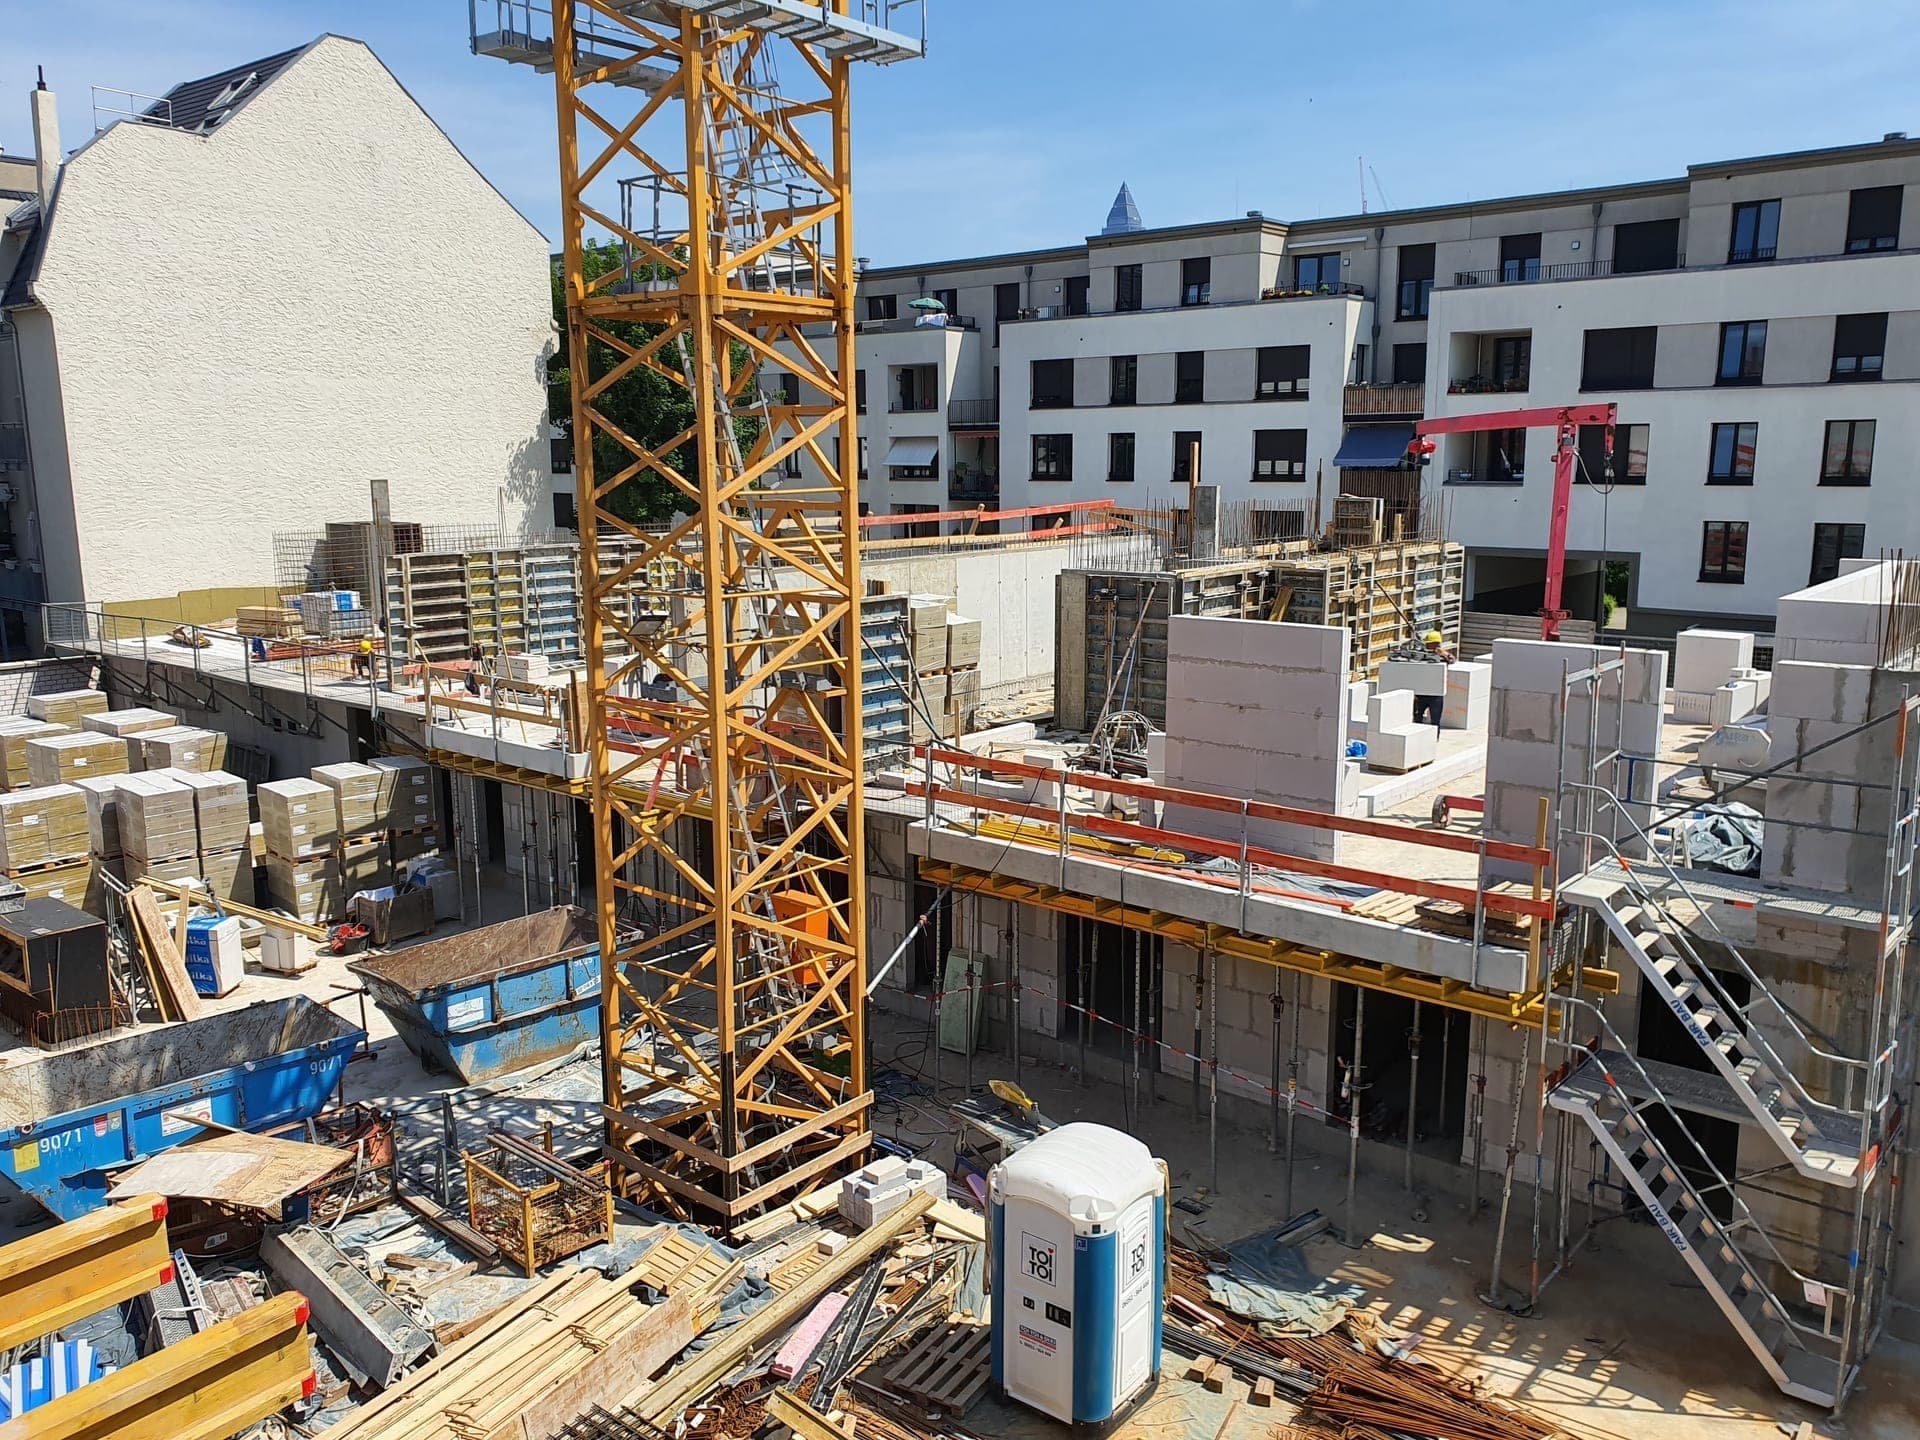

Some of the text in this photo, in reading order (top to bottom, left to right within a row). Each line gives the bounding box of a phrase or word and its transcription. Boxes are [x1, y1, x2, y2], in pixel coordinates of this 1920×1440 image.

[1670, 999, 1710, 1046] FAIR BAU
[310, 1054, 342, 1075] 9071
[40, 1128, 82, 1153] 9071
[1649, 1203, 1688, 1251] FAIR BAU
[1029, 1260, 1052, 1281] TOI
[1131, 1254, 1145, 1276] TOI
